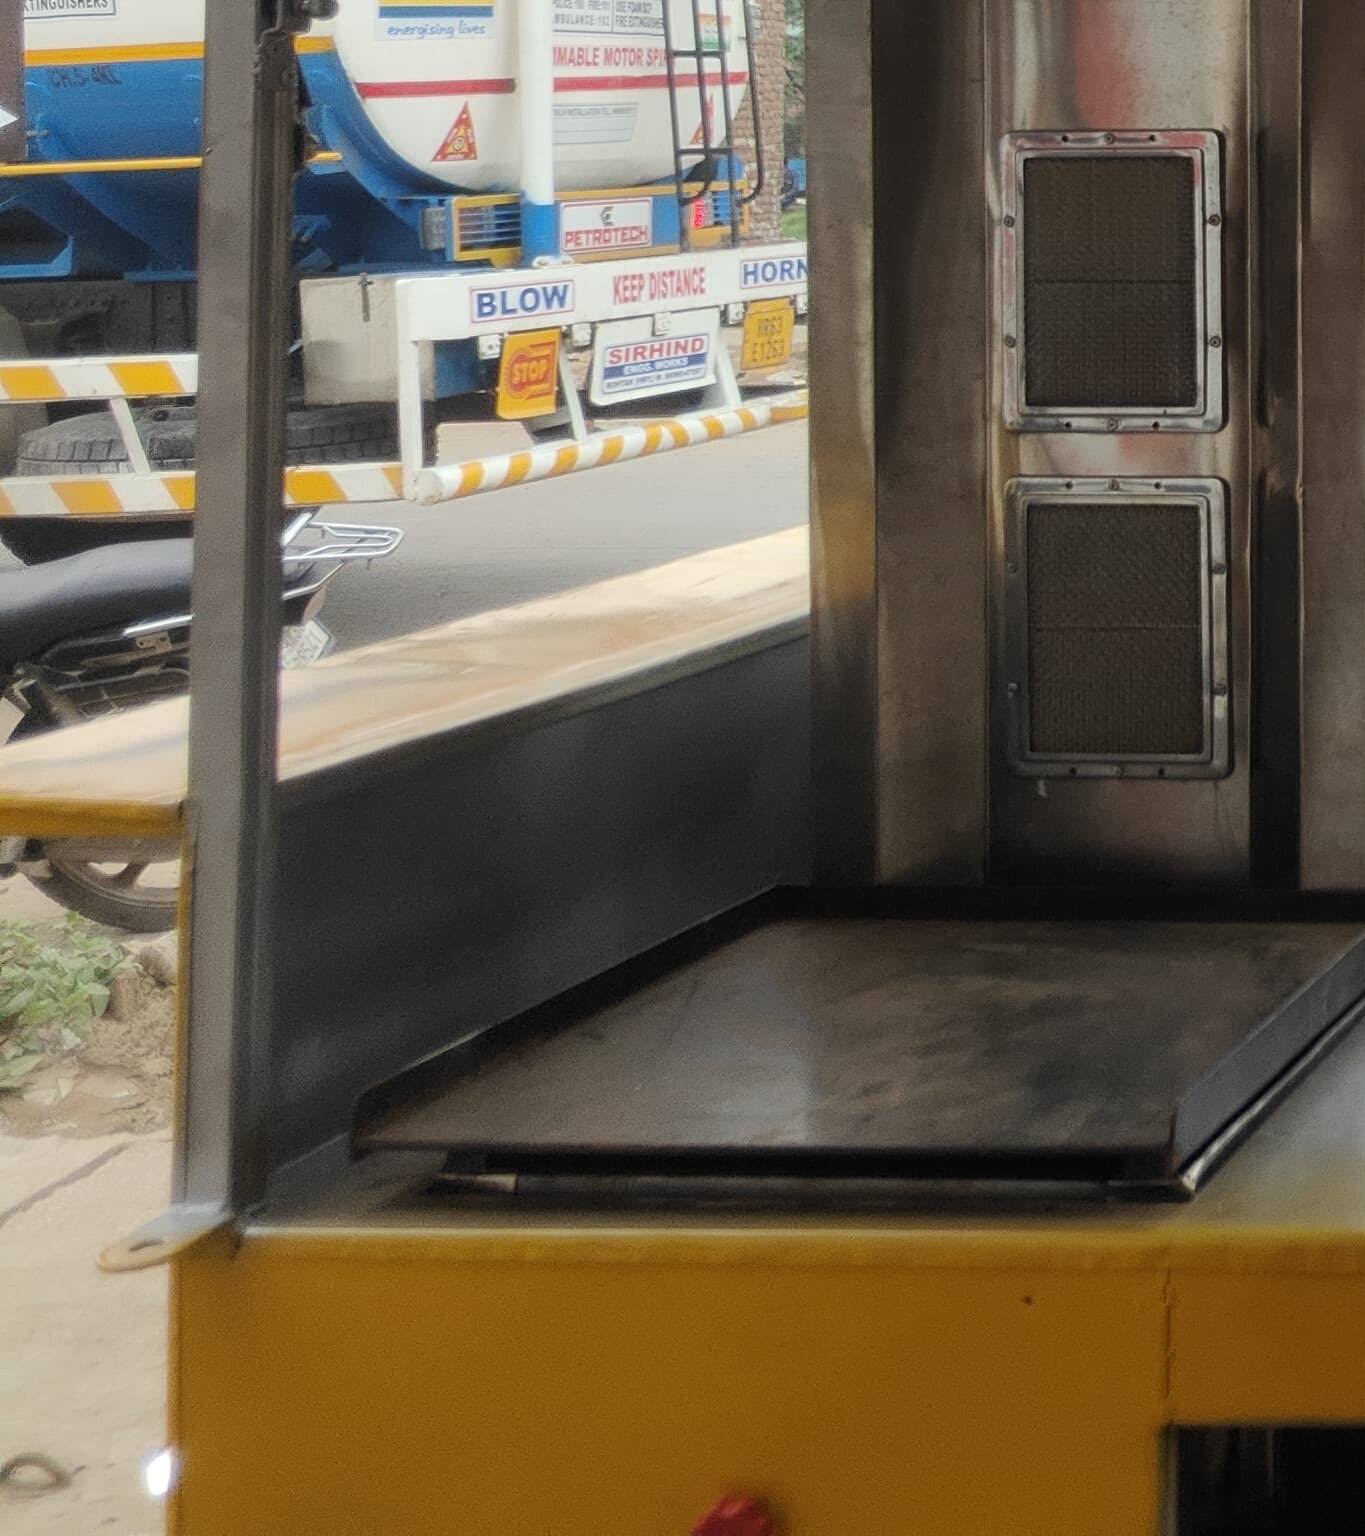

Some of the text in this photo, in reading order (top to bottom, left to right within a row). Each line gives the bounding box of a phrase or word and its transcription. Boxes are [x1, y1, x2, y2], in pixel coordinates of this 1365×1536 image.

[387, 20, 485, 39] energising lives
[604, 47, 644, 67] MOTOR
[563, 224, 648, 248] PETROTECH
[477, 284, 569, 318] BLOW
[612, 276, 645, 305] KEEP
[649, 267, 706, 301] DISTANCE
[608, 336, 705, 365] SIRHIND
[512, 360, 549, 384] STOP
